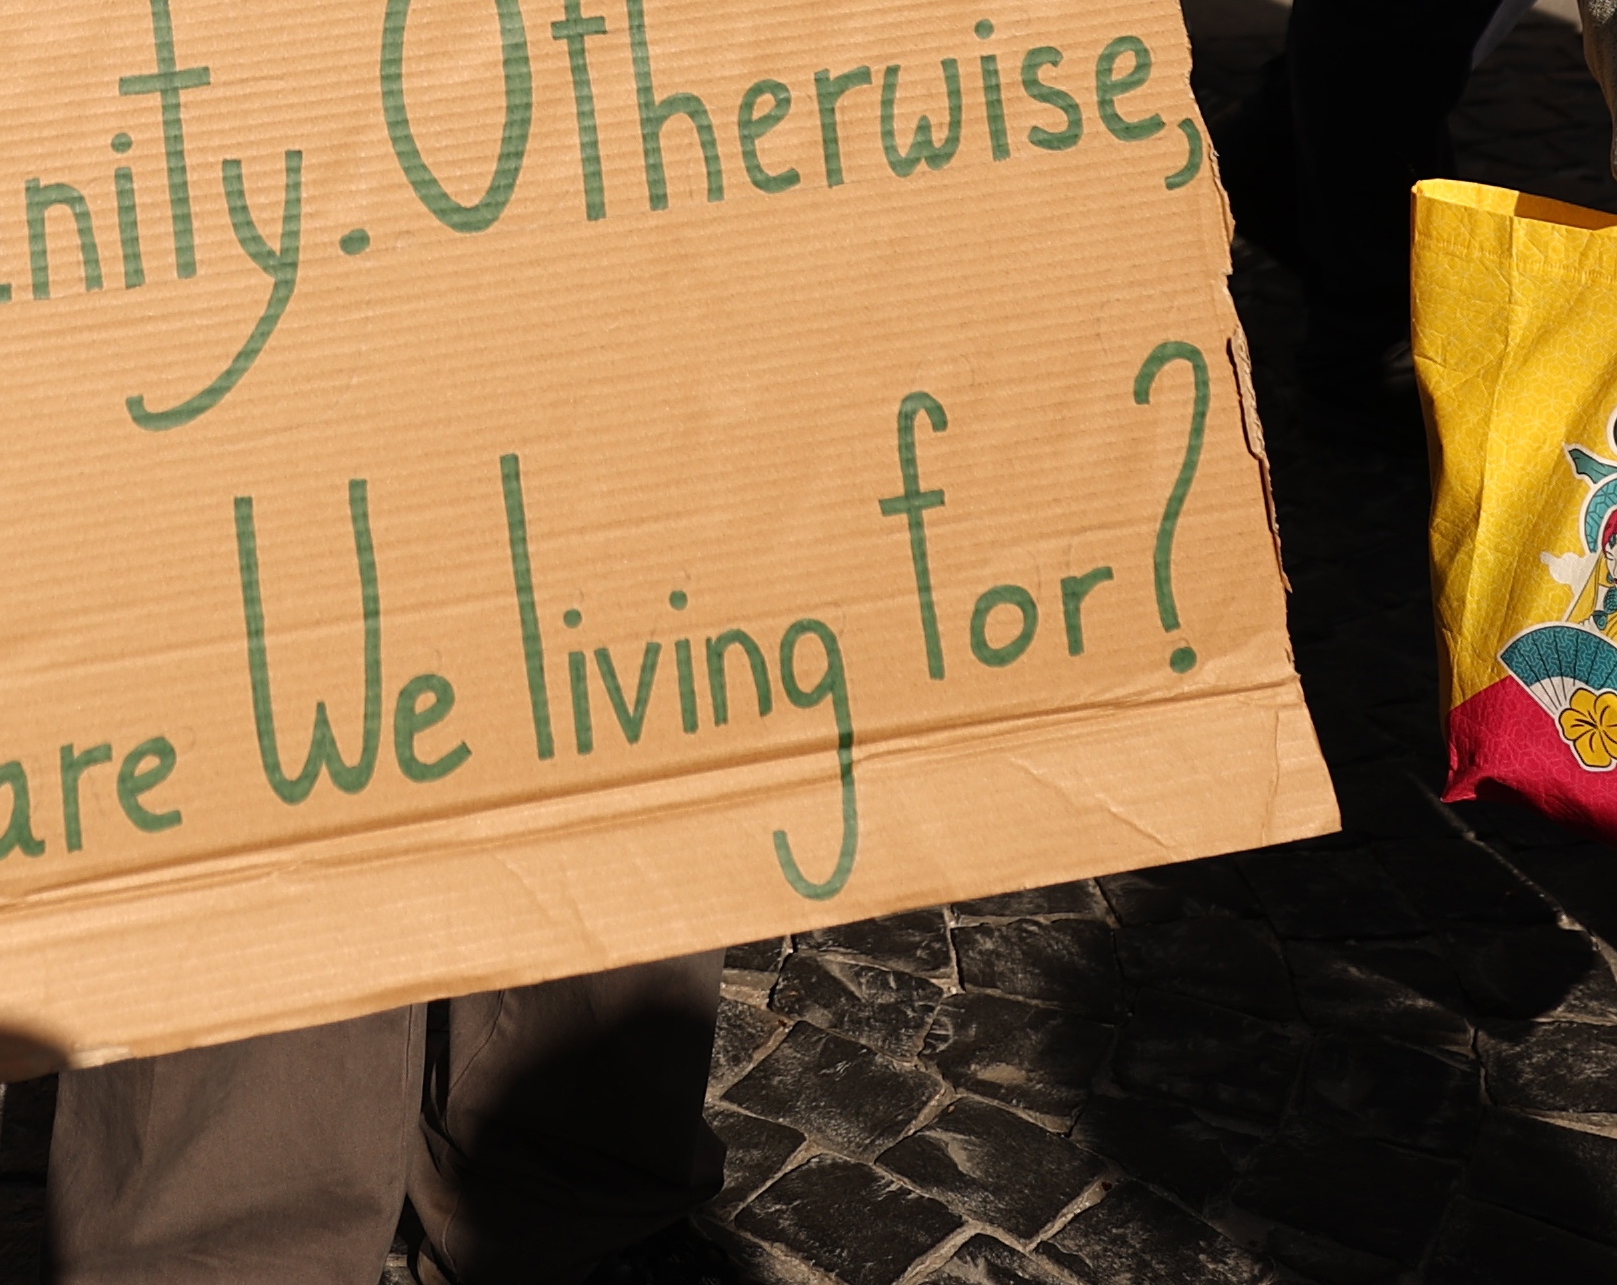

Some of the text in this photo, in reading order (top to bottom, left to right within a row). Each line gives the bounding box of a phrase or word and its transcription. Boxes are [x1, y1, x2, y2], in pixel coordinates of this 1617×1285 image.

[236, 480, 470, 802] We
[502, 455, 855, 898] living
[882, 343, 1209, 678] for?
